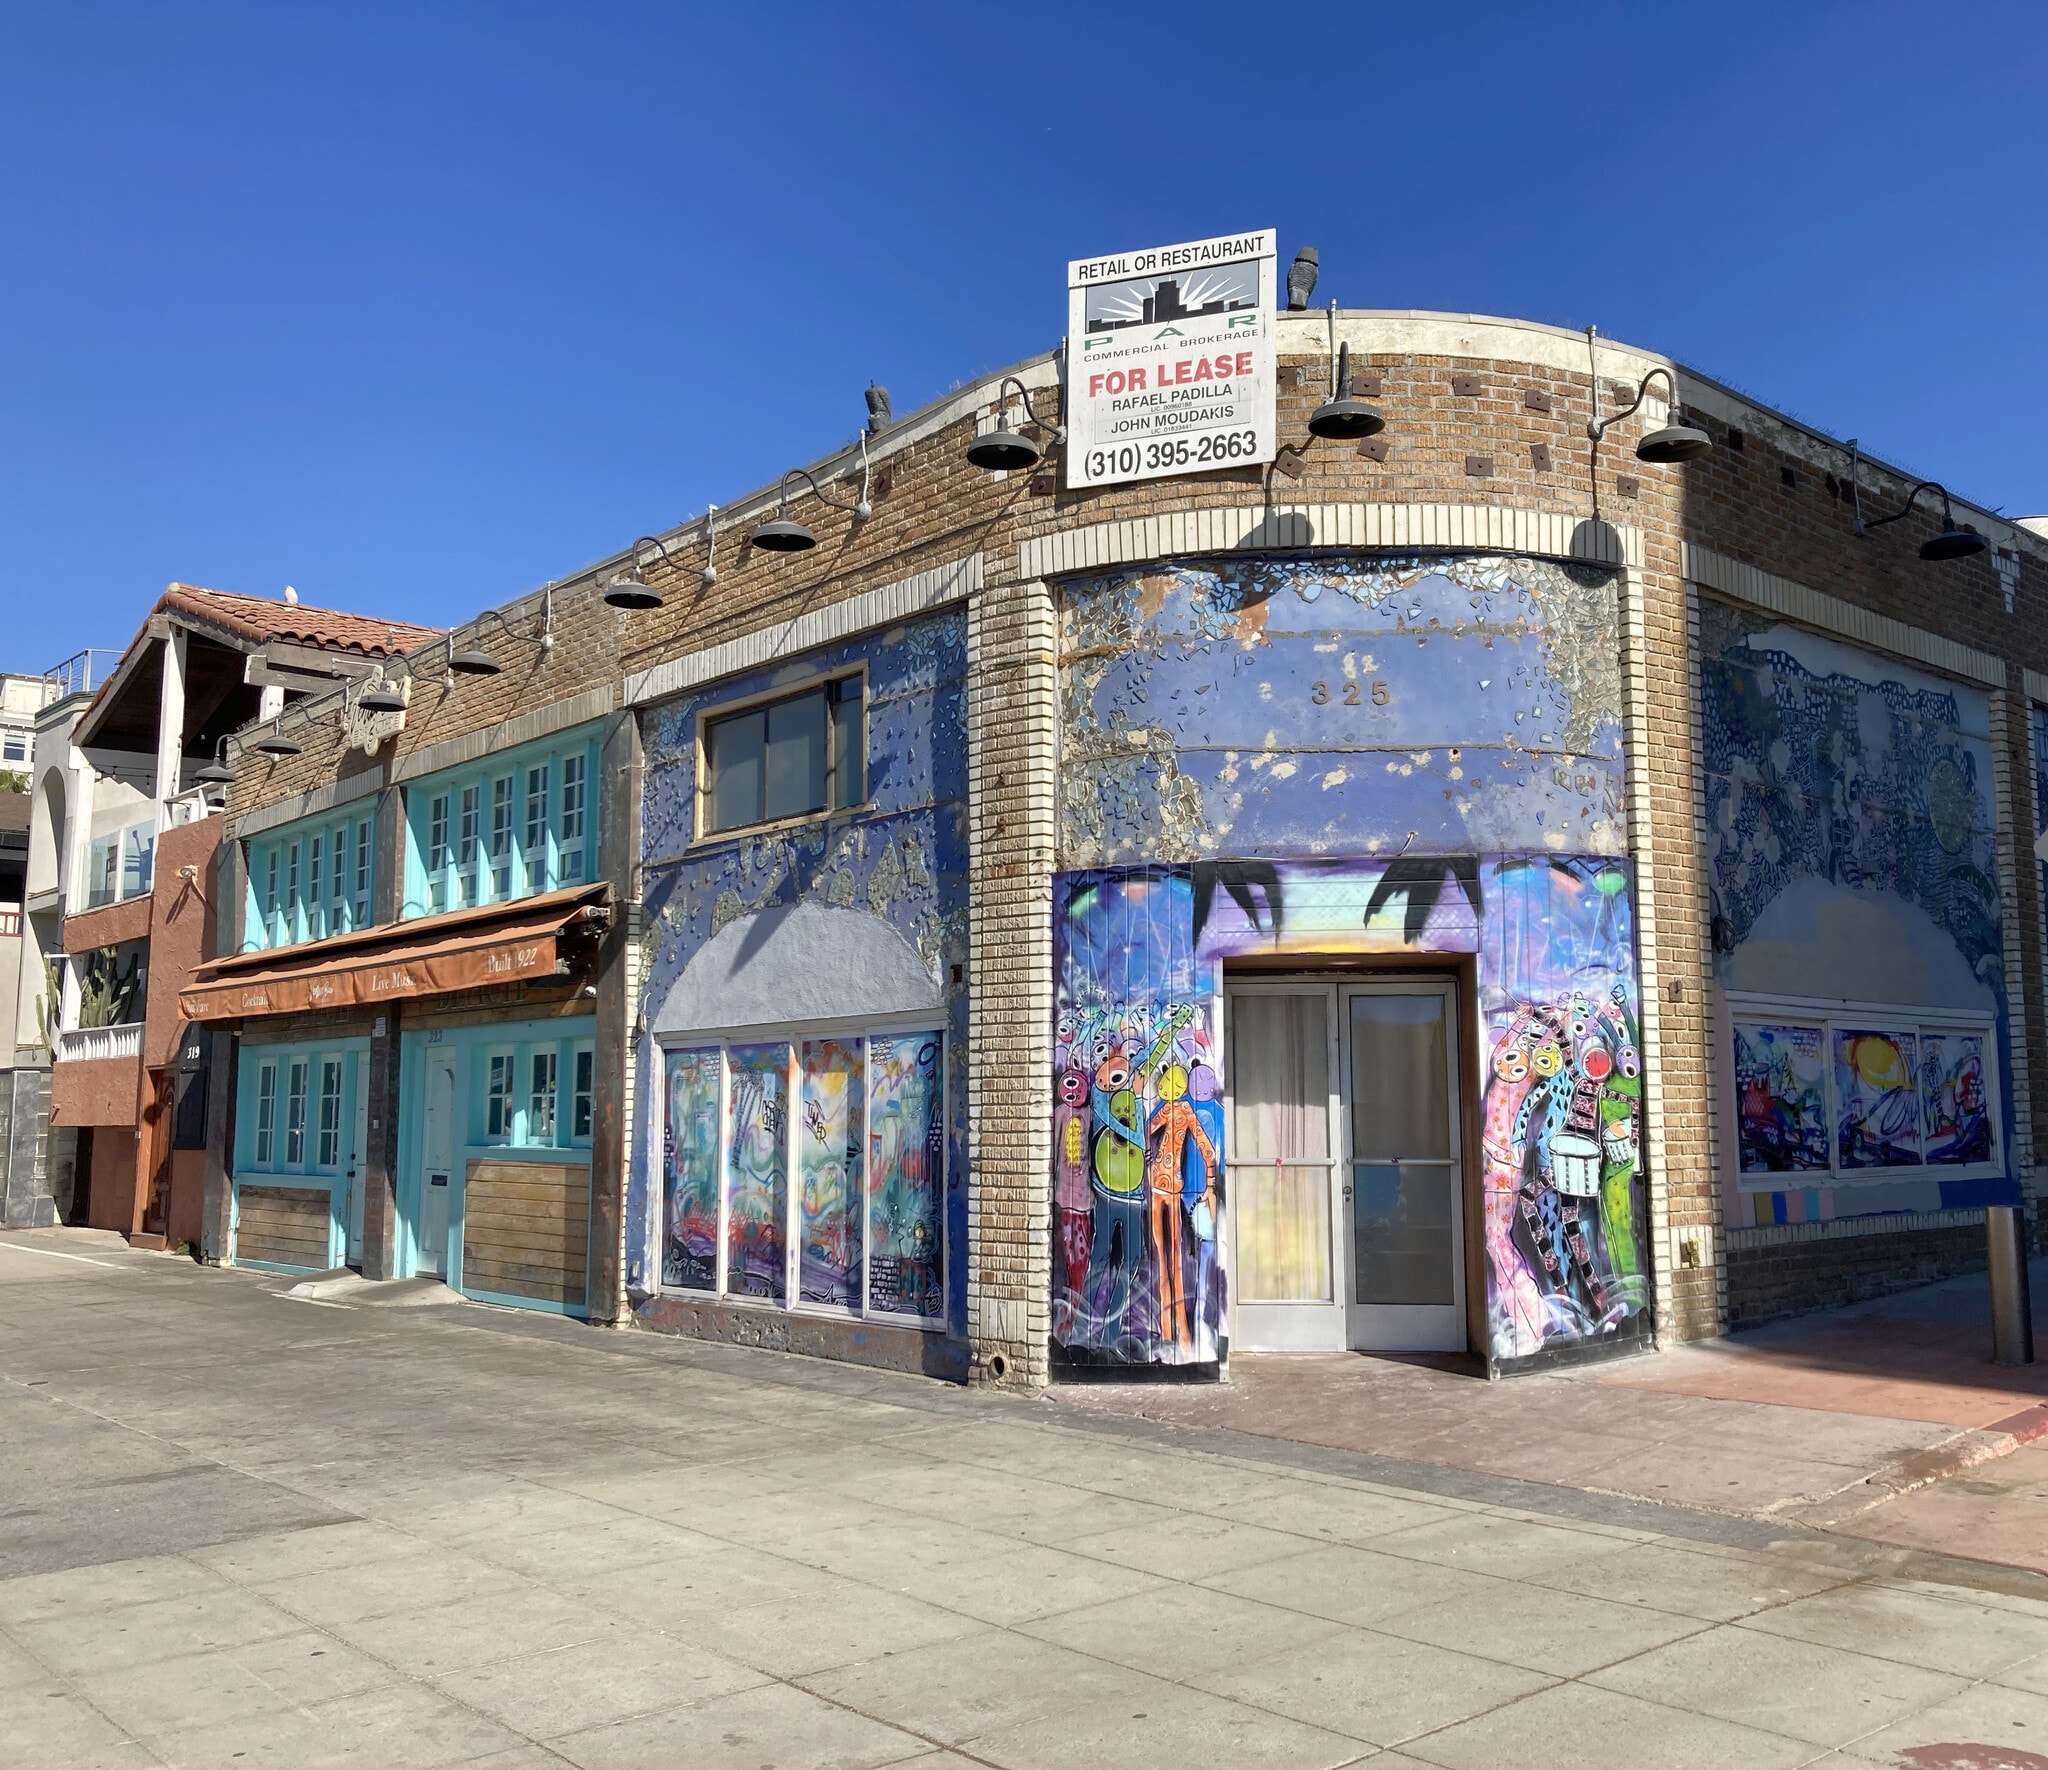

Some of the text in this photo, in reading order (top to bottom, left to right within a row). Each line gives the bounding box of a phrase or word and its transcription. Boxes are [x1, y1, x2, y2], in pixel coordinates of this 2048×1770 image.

[1078, 236, 1265, 280] RETAIL OR RESTAURANT
[1084, 328, 1259, 363] COMMERCIAL BROKERAGE
[1089, 351, 1253, 398] FOR LEASE
[1112, 384, 1233, 412] RAFAEL PADILLA
[1111, 405, 1234, 434] JOHN MOUDAKIS
[1084, 430, 1257, 480] (310) 395-2663
[1311, 680, 1391, 706] 325
[488, 947, 538, 973] Built 1922
[371, 974, 389, 992] Live
[428, 1030, 443, 1043] 323
[186, 1045, 200, 1060] 319
